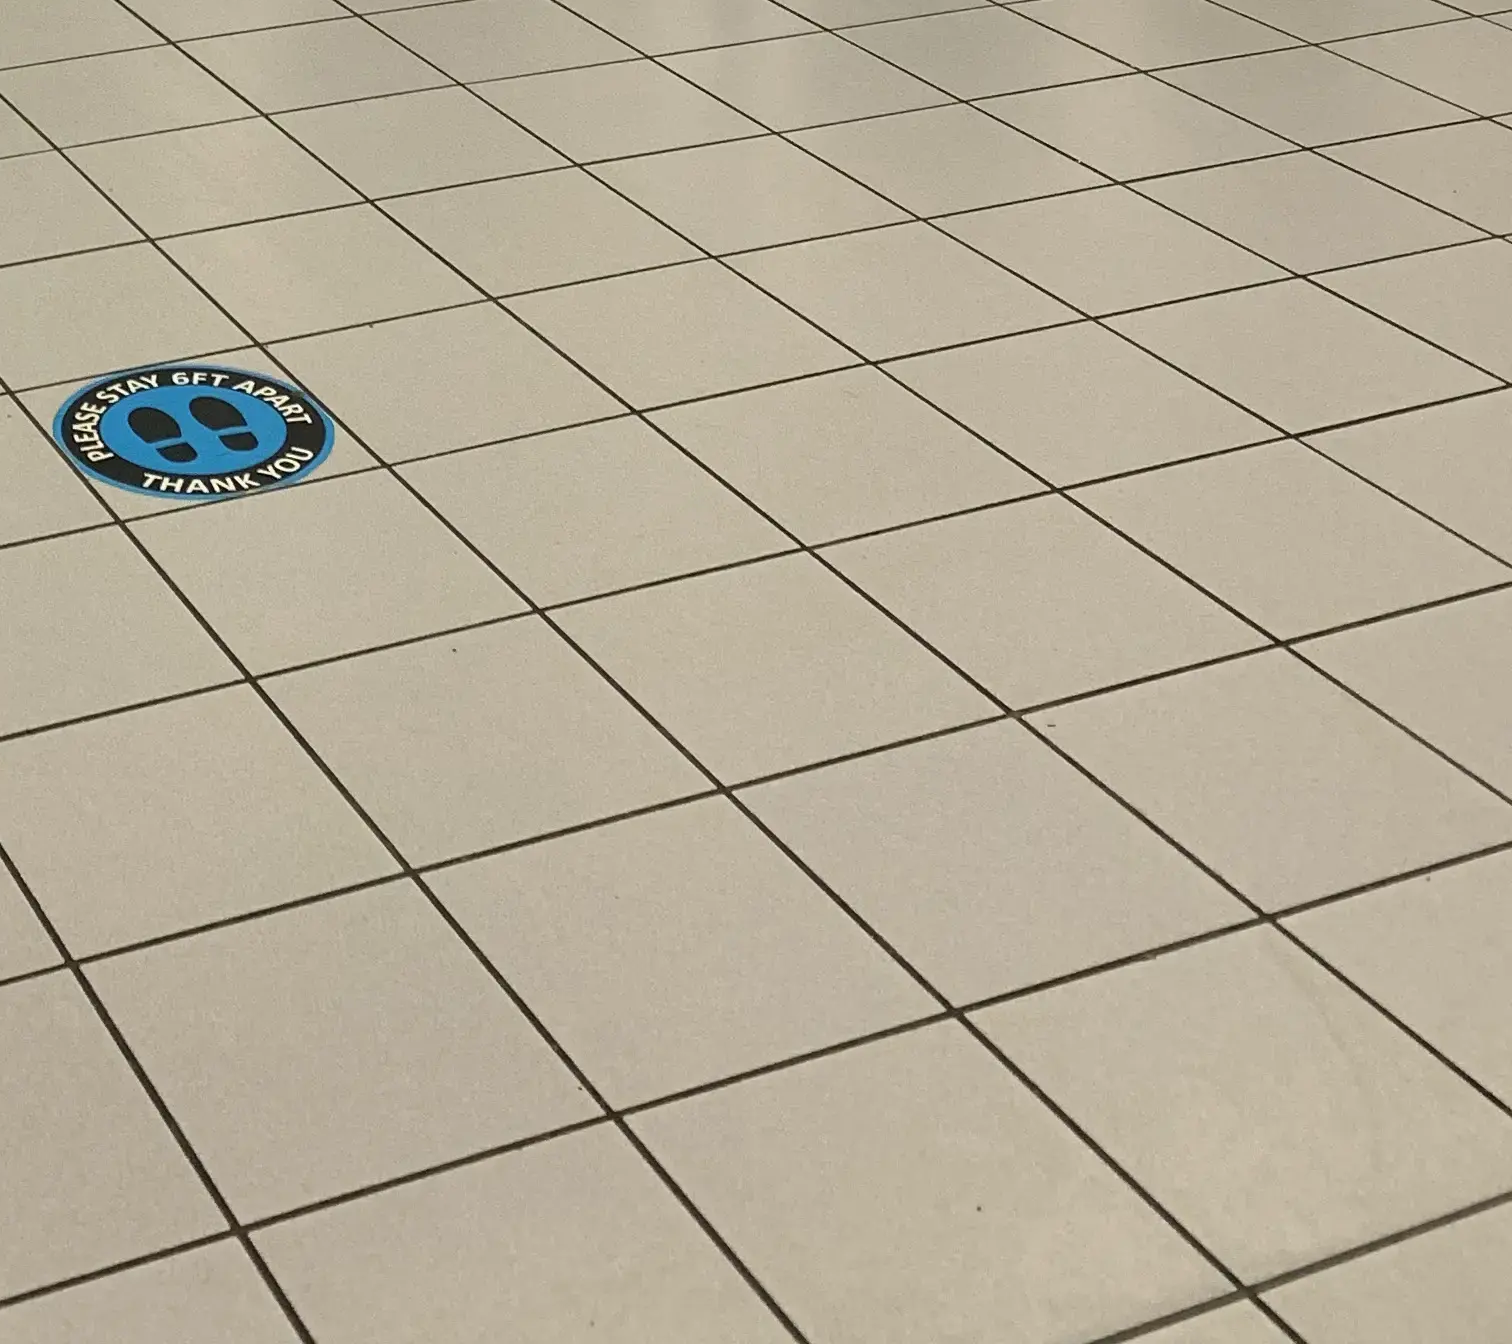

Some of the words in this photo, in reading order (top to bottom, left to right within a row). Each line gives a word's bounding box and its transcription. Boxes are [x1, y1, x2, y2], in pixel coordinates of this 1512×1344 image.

[73, 402, 114, 463] PLEASE
[96, 374, 160, 404] STAY
[172, 372, 230, 386] 6FT
[232, 380, 313, 426] APART
[142, 472, 261, 495] THANK
[257, 447, 314, 481] YOU
